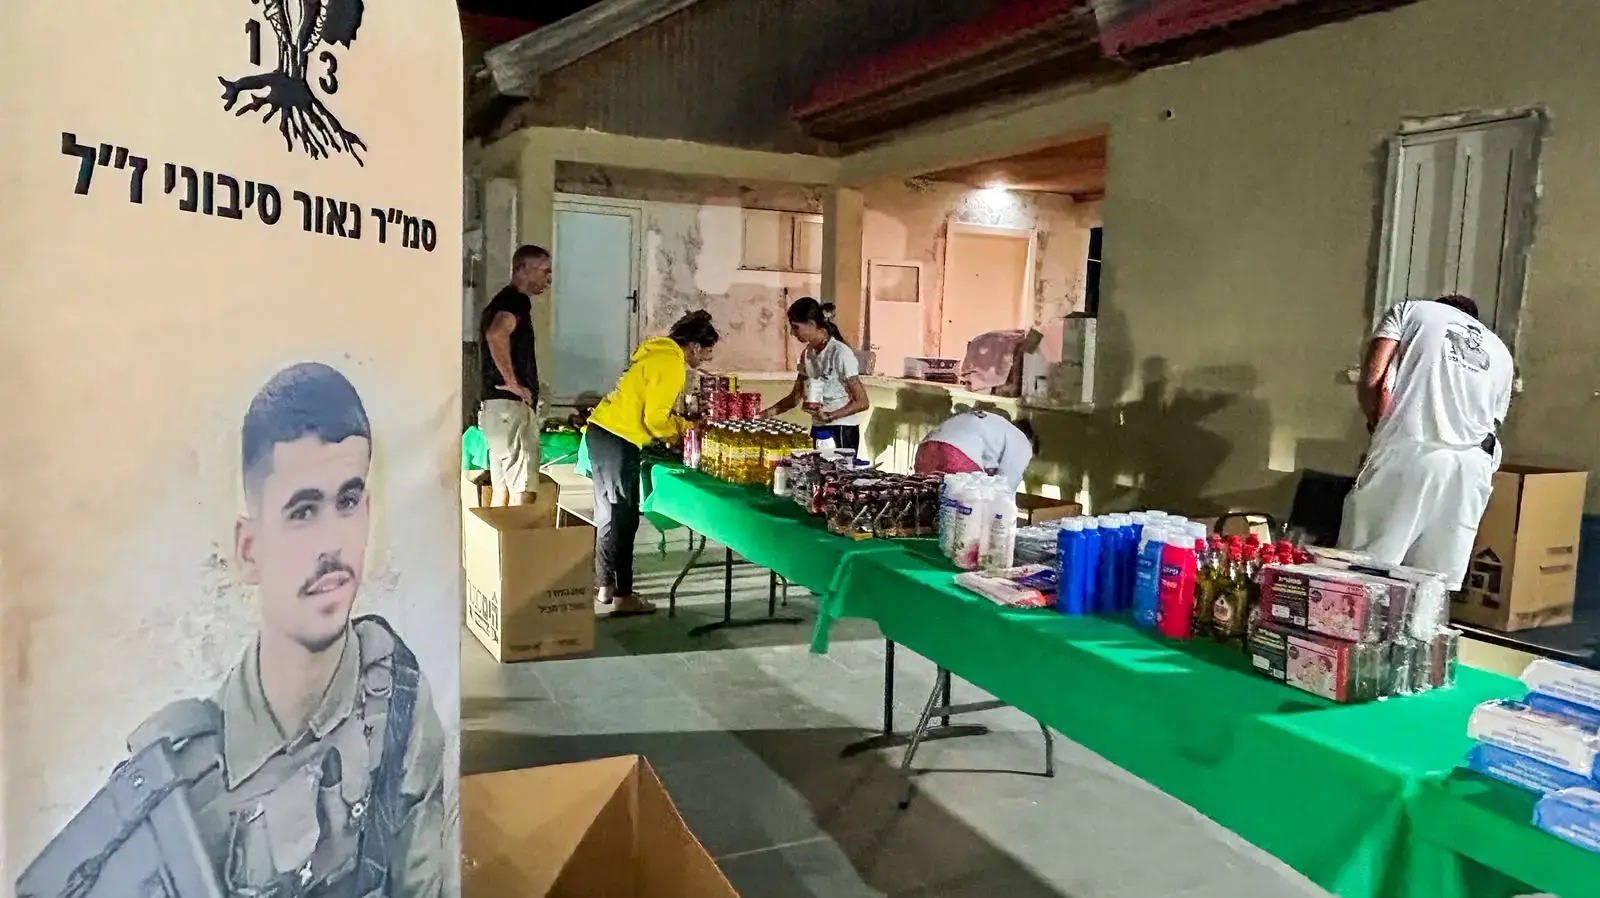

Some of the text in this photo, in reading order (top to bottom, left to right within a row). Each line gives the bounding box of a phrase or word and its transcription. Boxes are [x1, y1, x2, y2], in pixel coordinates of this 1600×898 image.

[245, 18, 339, 95] 1 3
[61, 131, 438, 253] סמ"ר נאור סיבוני ז"ל
